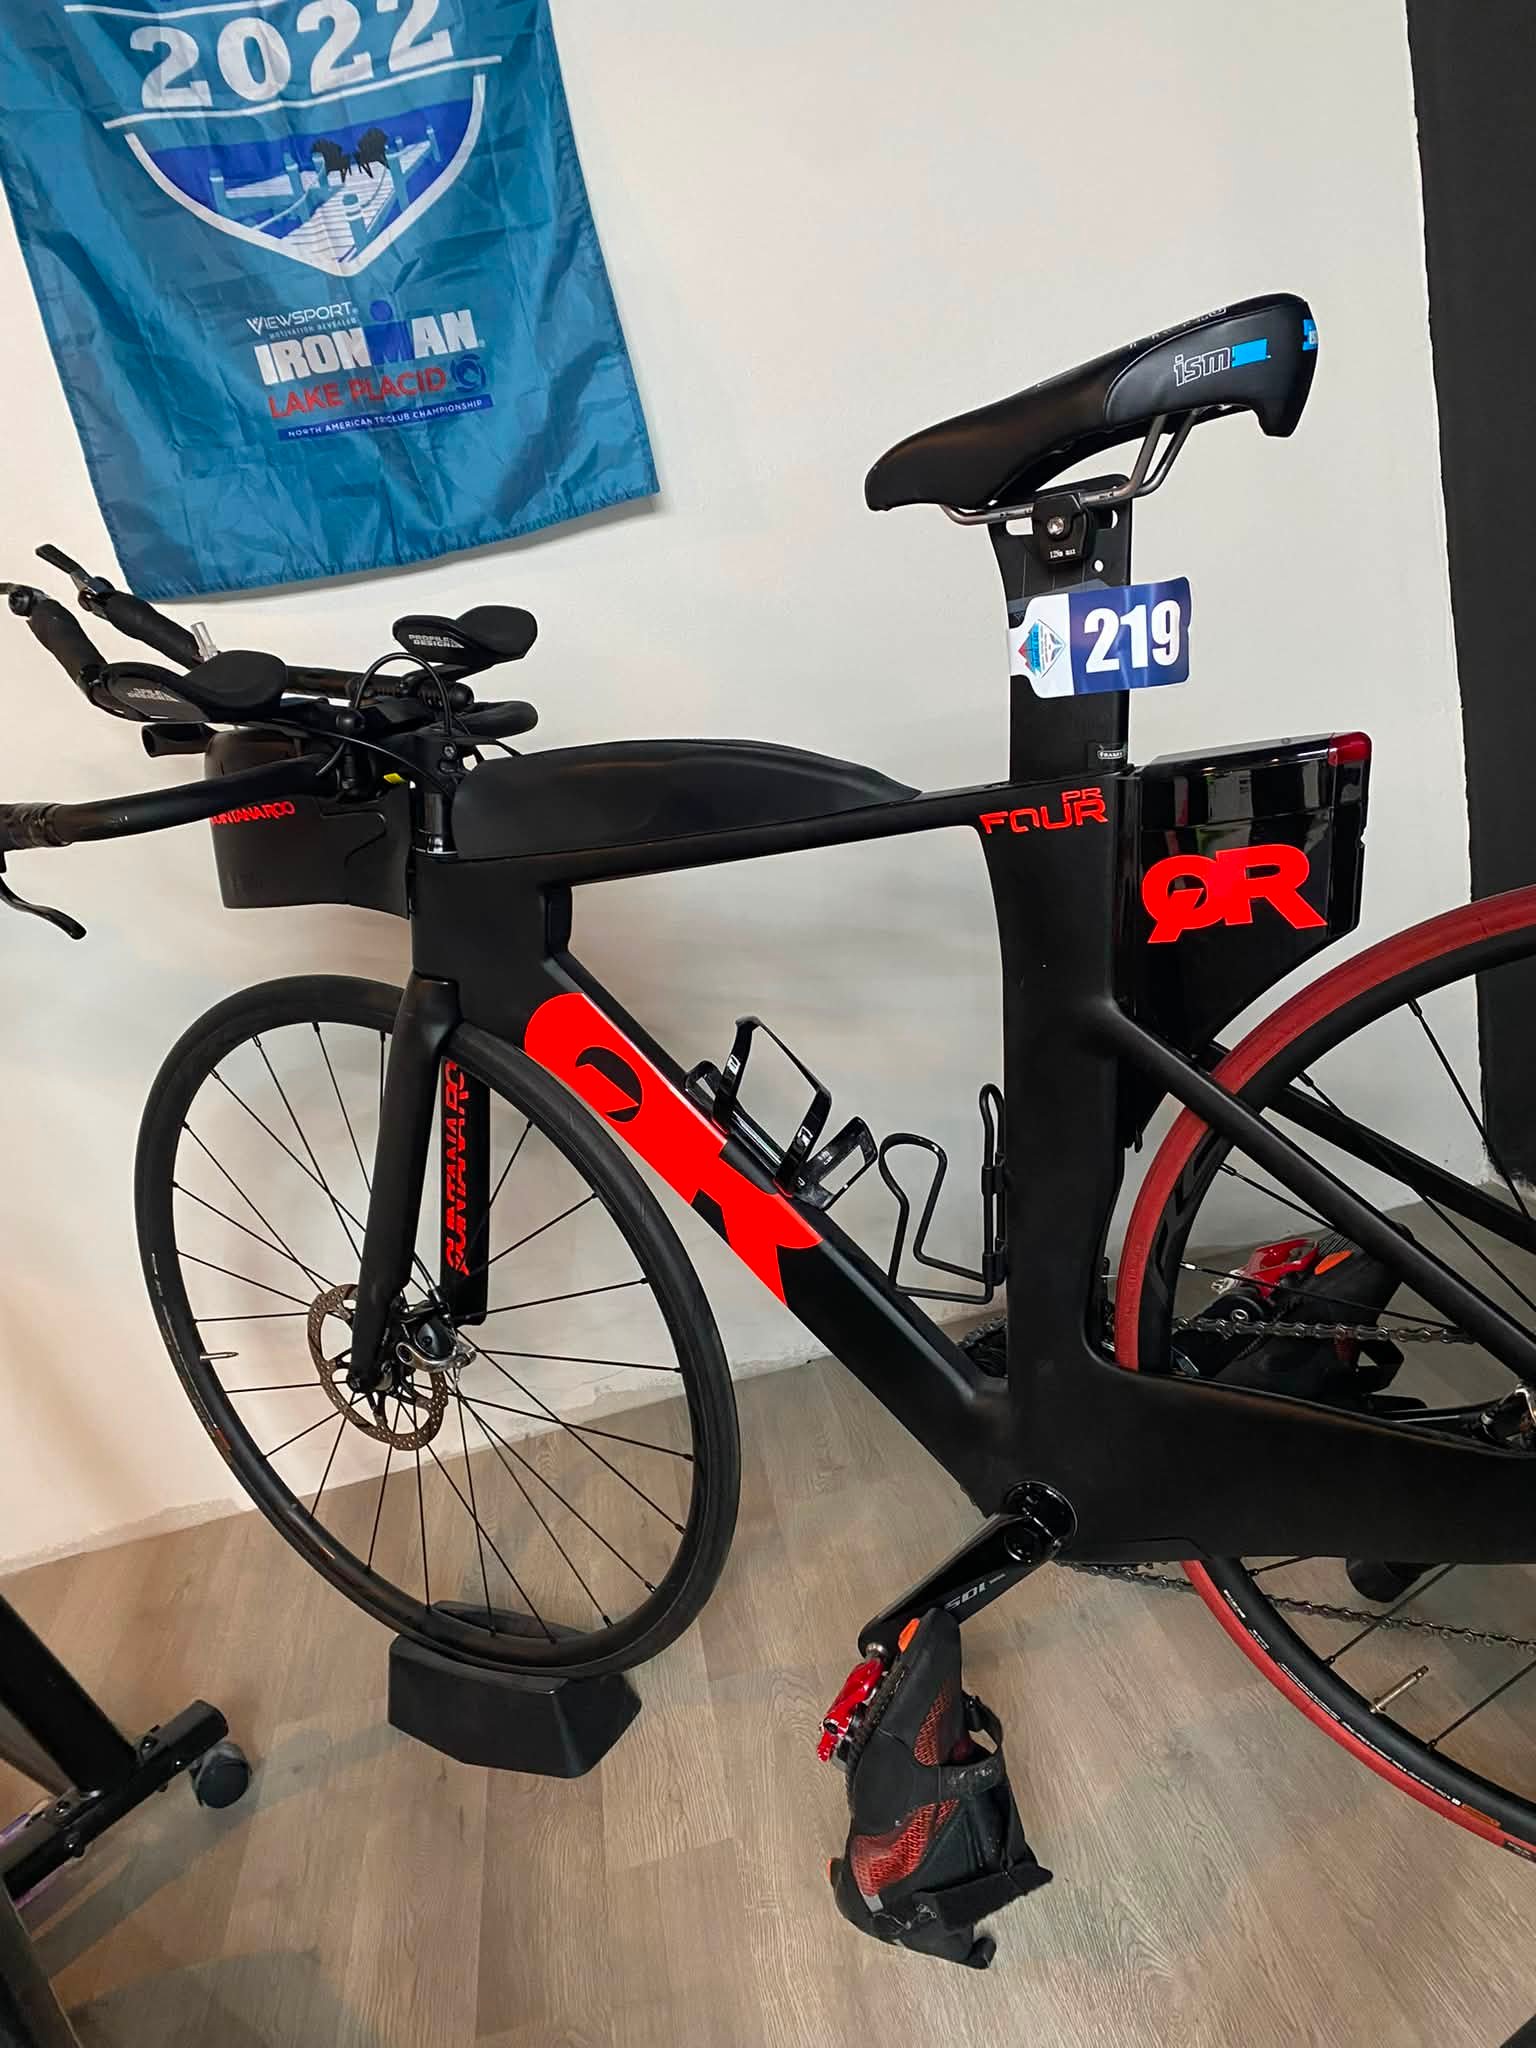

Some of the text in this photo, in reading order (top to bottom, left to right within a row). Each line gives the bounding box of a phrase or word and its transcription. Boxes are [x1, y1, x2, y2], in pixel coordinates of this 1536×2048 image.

[130, 0, 454, 109] 2022
[246, 301, 353, 336] VIEWSPORT
[268, 325, 315, 339] MOTIVATION
[254, 300, 479, 386] IRONMAN
[1173, 347, 1231, 387] ism
[267, 366, 447, 420] LAKE PLACID
[288, 426, 322, 438] NORTH
[324, 417, 373, 432] AMERICAN
[412, 399, 483, 420] CHAMPIONSHIP
[413, 639, 452, 648] DESIGN
[1084, 600, 1181, 674] 219
[1061, 788, 1103, 802] PR
[979, 799, 1109, 834] FOUR
[1142, 843, 1328, 944] QR
